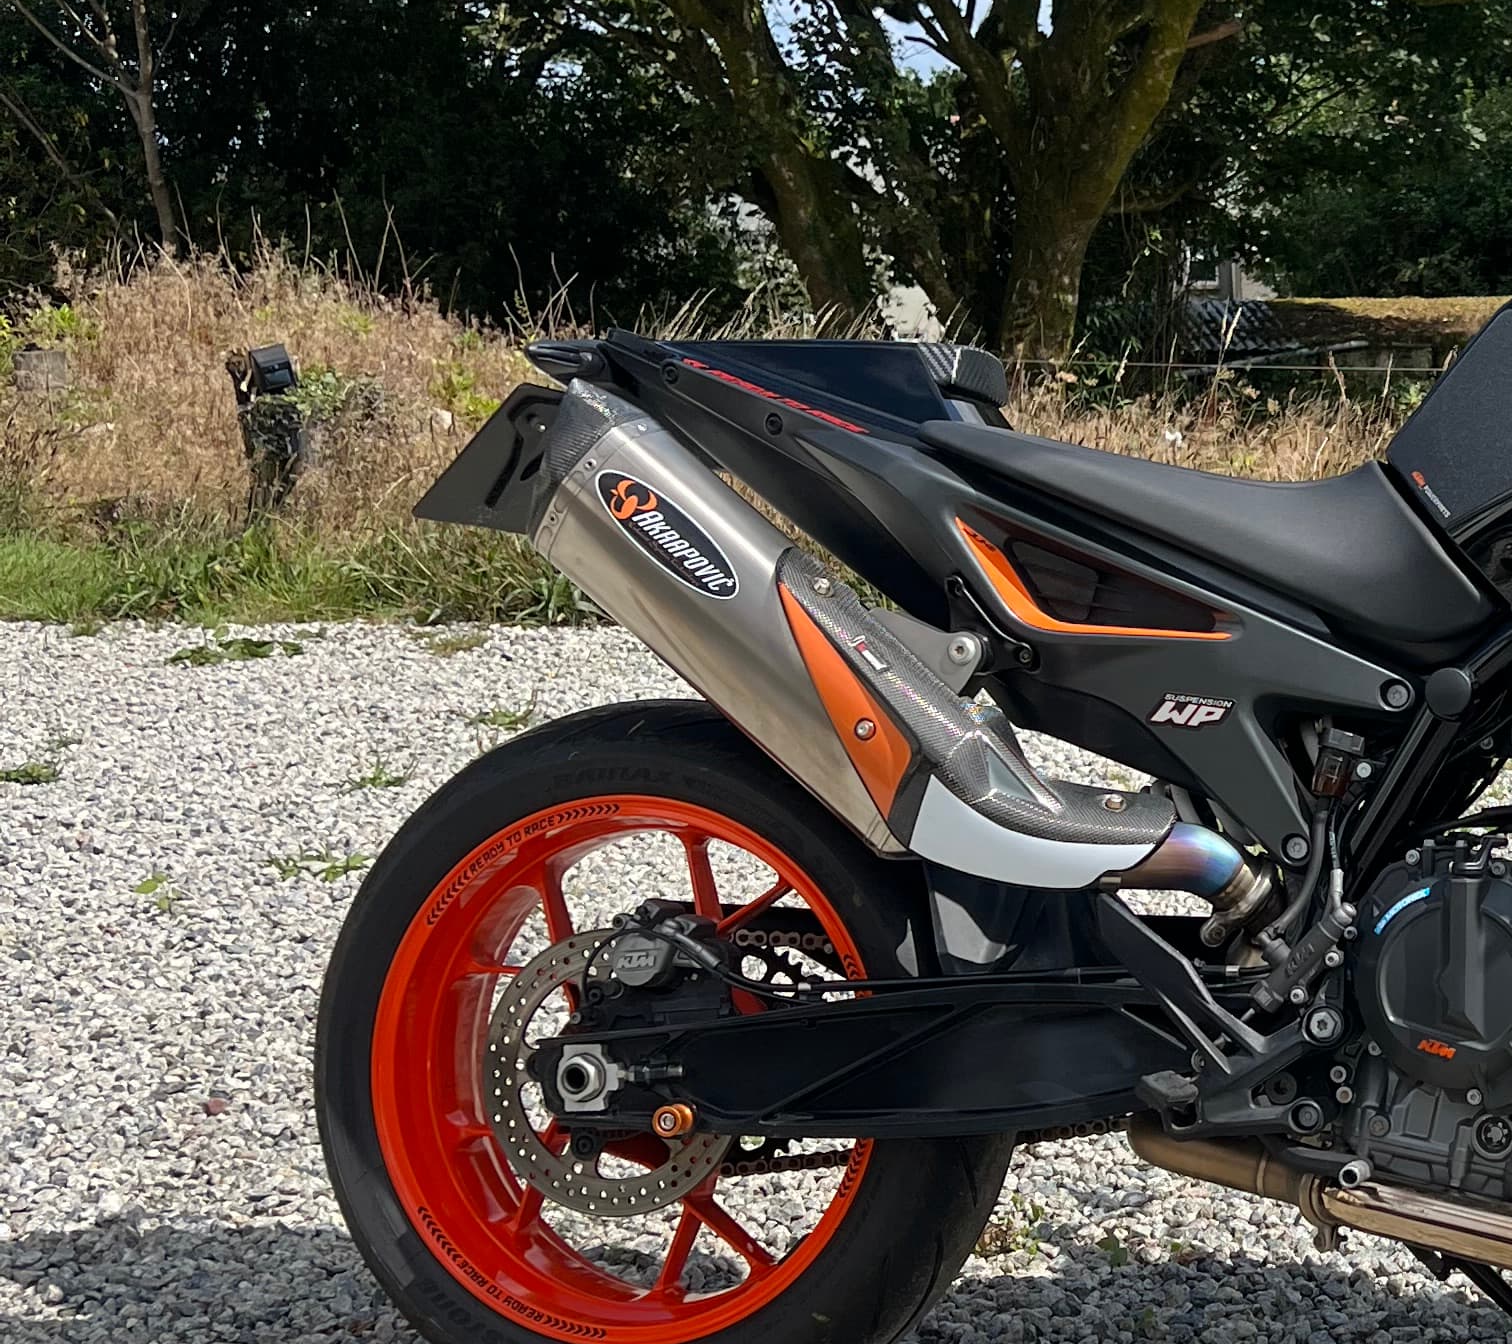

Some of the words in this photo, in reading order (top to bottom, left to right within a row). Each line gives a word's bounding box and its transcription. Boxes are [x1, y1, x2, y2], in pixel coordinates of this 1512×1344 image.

[1164, 693, 1232, 708] SUSPENSION
[1150, 700, 1226, 726] WP
[469, 844, 505, 875] READY
[506, 830, 522, 847] TO
[523, 815, 555, 838] RACE
[616, 951, 655, 969] KTM
[1417, 1039, 1457, 1059] KTM
[457, 1258, 489, 1288] RACE
[486, 1283, 506, 1301] TO
[502, 1296, 546, 1323] READY
